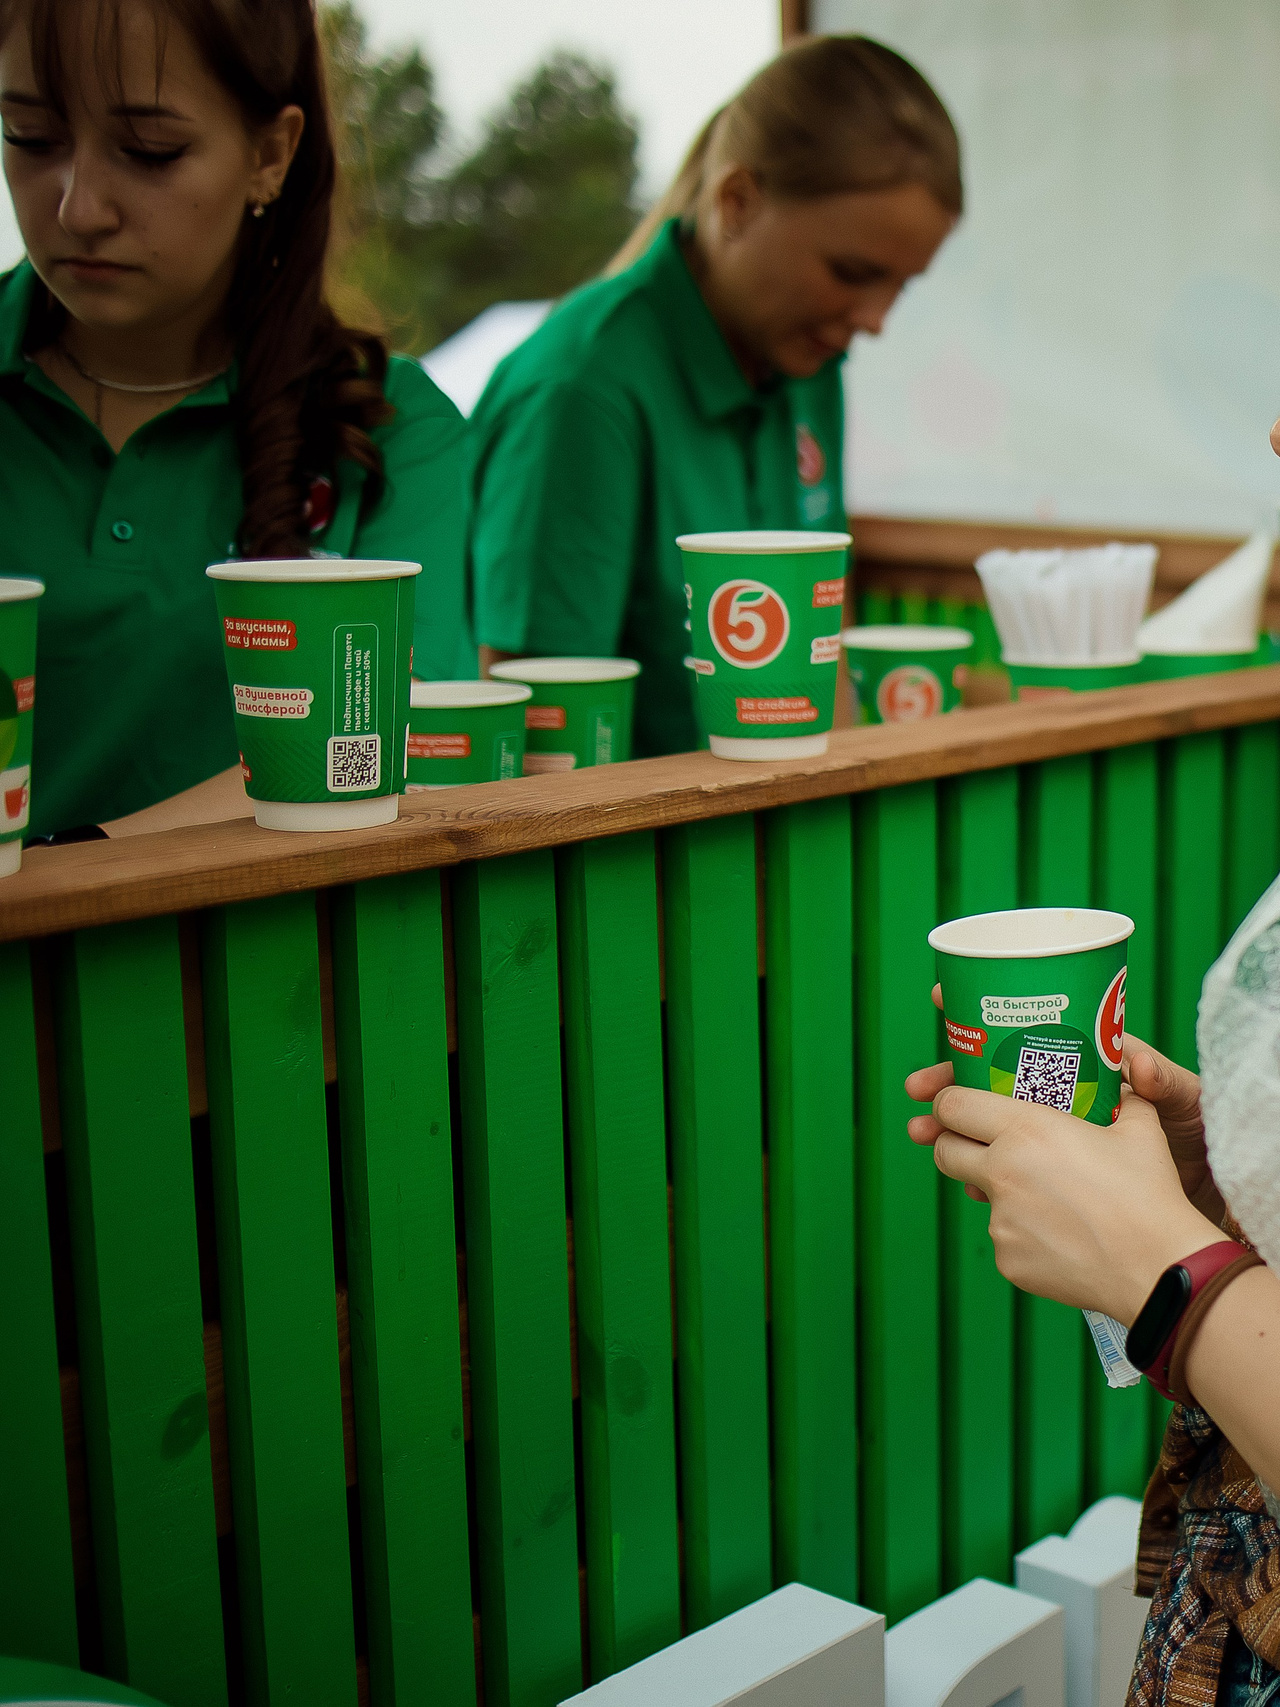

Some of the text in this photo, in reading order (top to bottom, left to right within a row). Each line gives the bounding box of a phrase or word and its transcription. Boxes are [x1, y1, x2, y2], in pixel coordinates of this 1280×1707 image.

[727, 585, 769, 652] 5
[225, 619, 291, 635] За вкусным,
[227, 634, 289, 648] как у мамы
[354, 649, 362, 668] чай
[363, 650, 371, 670] 50%
[344, 633, 353, 732] Подписчики Пакета
[234, 686, 308, 702] За душевной
[354, 679, 363, 704] кофе
[363, 672, 371, 724] кешбэком
[237, 701, 306, 716] атмосферой
[741, 700, 754, 710] За
[984, 996, 1063, 1011] За быстрой
[986, 1011, 1057, 1023] доставкой
